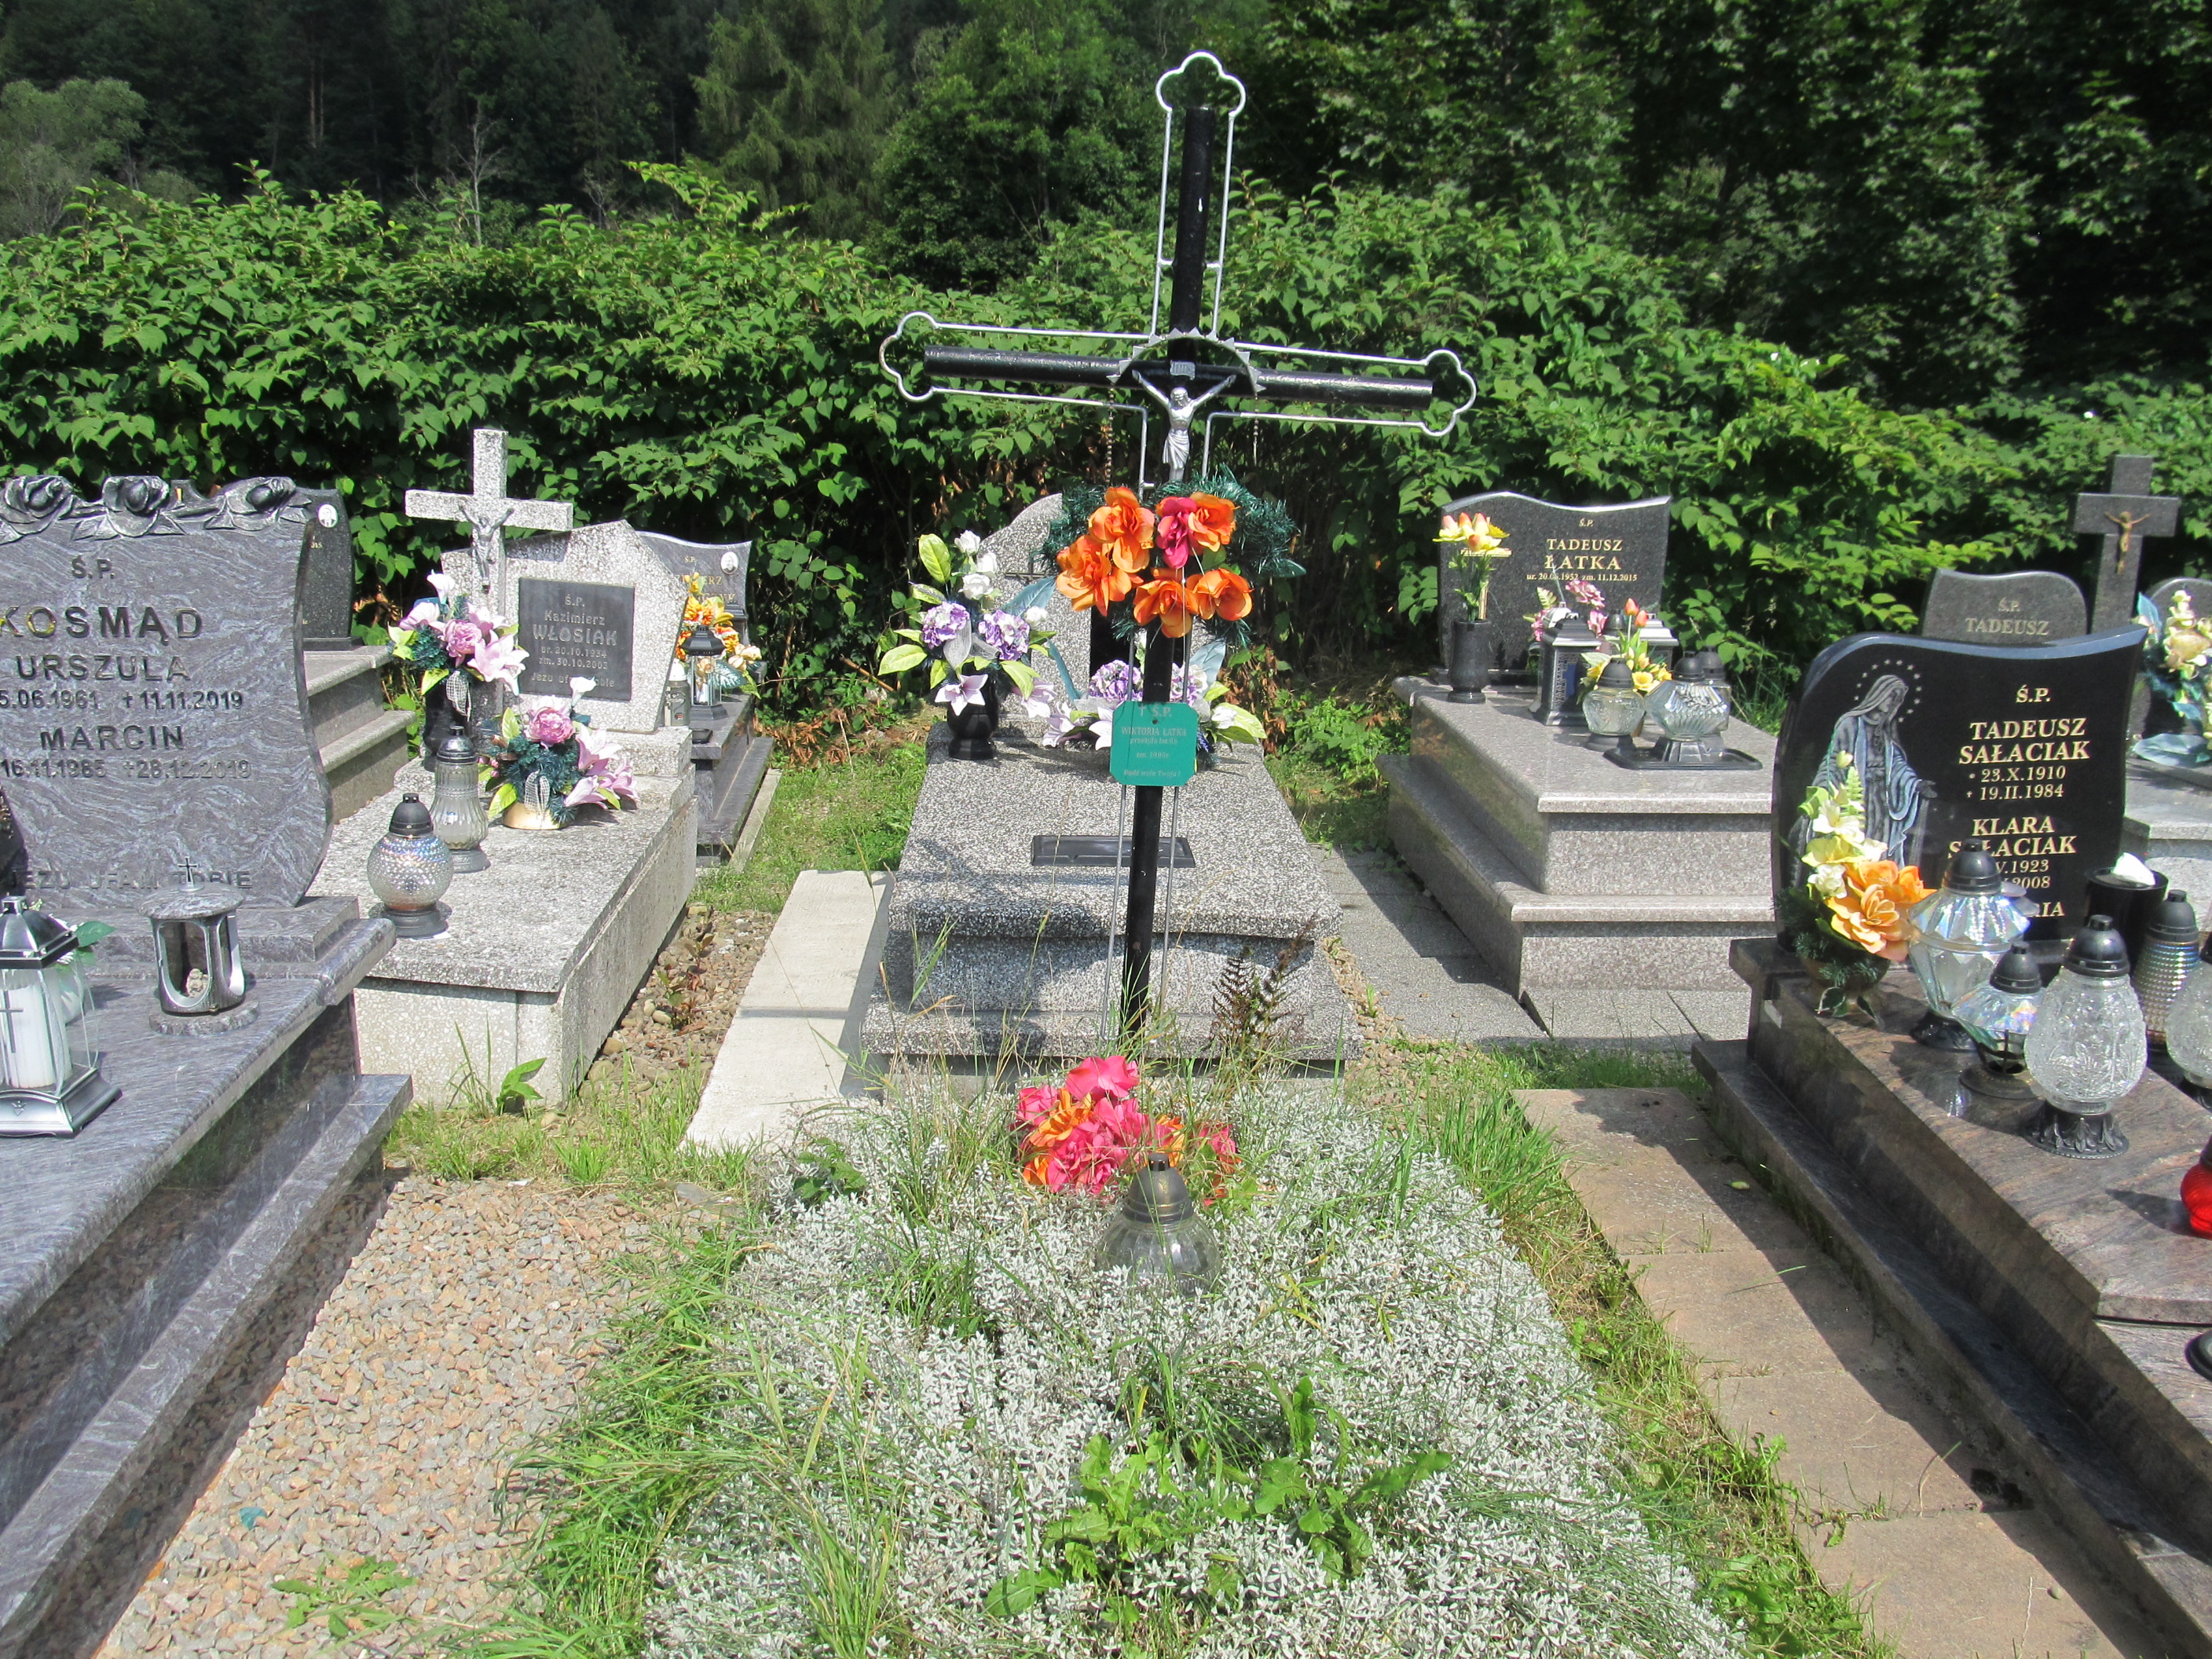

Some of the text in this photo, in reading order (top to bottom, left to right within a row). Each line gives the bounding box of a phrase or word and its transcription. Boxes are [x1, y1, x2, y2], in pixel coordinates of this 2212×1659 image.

[1579, 518, 1594, 527] Ś.P.
[1546, 539, 1623, 551] TADEUSZ
[1544, 555, 1622, 570] ŁATKA
[1598, 573, 1638, 582] 11.12.2015
[565, 594, 585, 608] Ś.P.
[1998, 597, 2020, 613] Ś.P.
[0, 606, 203, 646] KOSMĄD
[544, 610, 606, 626] Kazimierz
[1965, 617, 2049, 635] TADEUSZ
[533, 624, 617, 646] WŁOSIAK
[555, 646, 608, 659] 20.10.1934
[16, 655, 191, 681] URSZULA
[531, 672, 554, 683] Jezu
[2016, 684, 2052, 703] Ś.P.
[1152, 703, 1172, 717] Ś.P.
[40, 725, 185, 750] MARCIN
[1121, 727, 1187, 737] WIKTORIA ŁATKA
[1969, 718, 2087, 741] TADEUSZ
[1958, 741, 2091, 764] SAŁACIAK
[1980, 766, 2067, 783] 23.X.1910
[1979, 784, 2064, 800] 19.II.1984
[1972, 816, 2055, 837] KLARA
[1947, 836, 2078, 859] SŁACIAK
